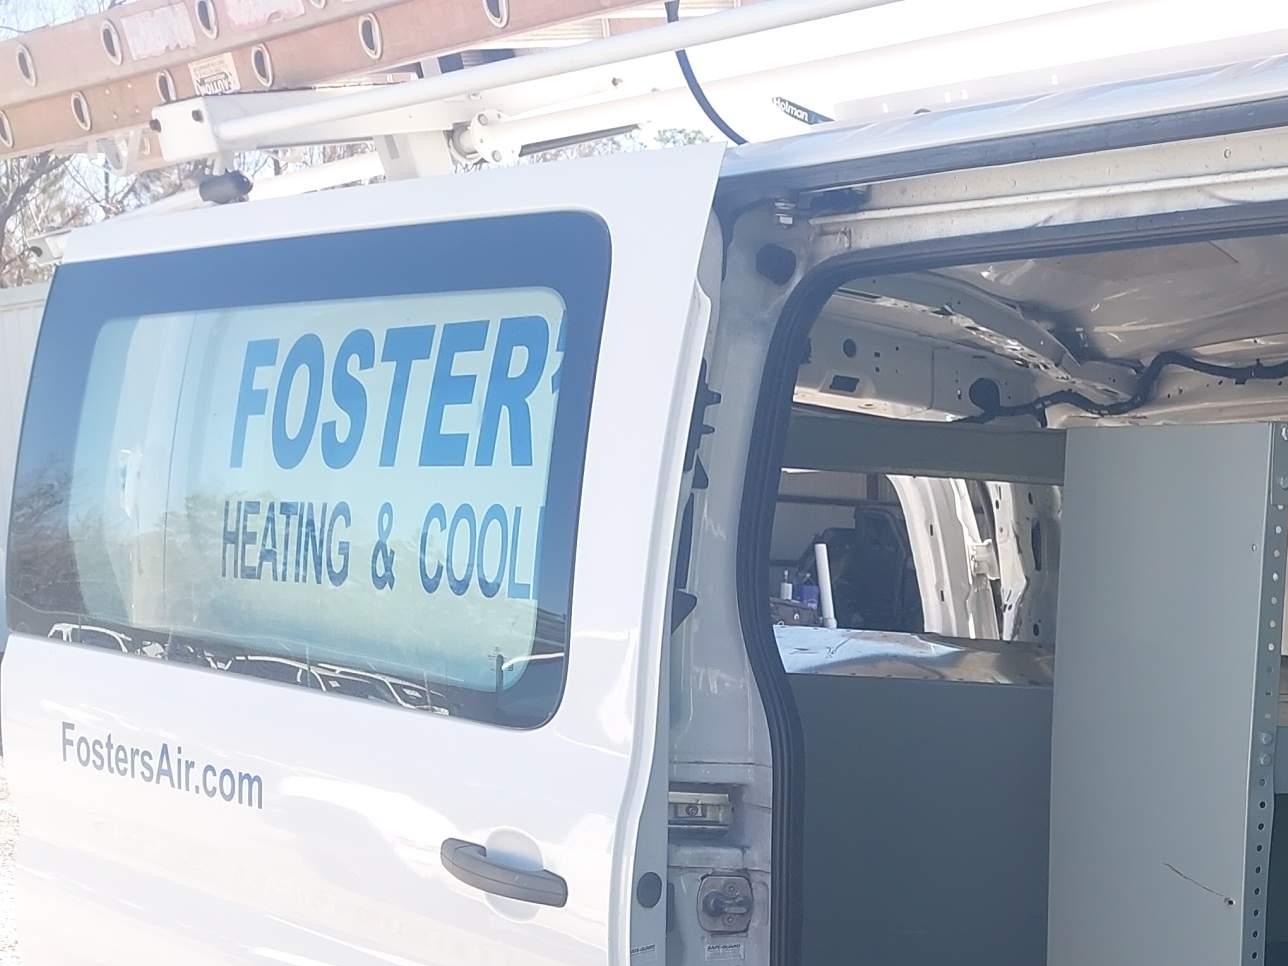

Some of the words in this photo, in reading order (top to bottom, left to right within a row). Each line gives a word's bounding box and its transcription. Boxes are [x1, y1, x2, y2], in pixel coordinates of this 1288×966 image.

[221, 500, 352, 588] HEATING
[371, 501, 396, 591] &
[62, 721, 263, 809] FostersAir.com
